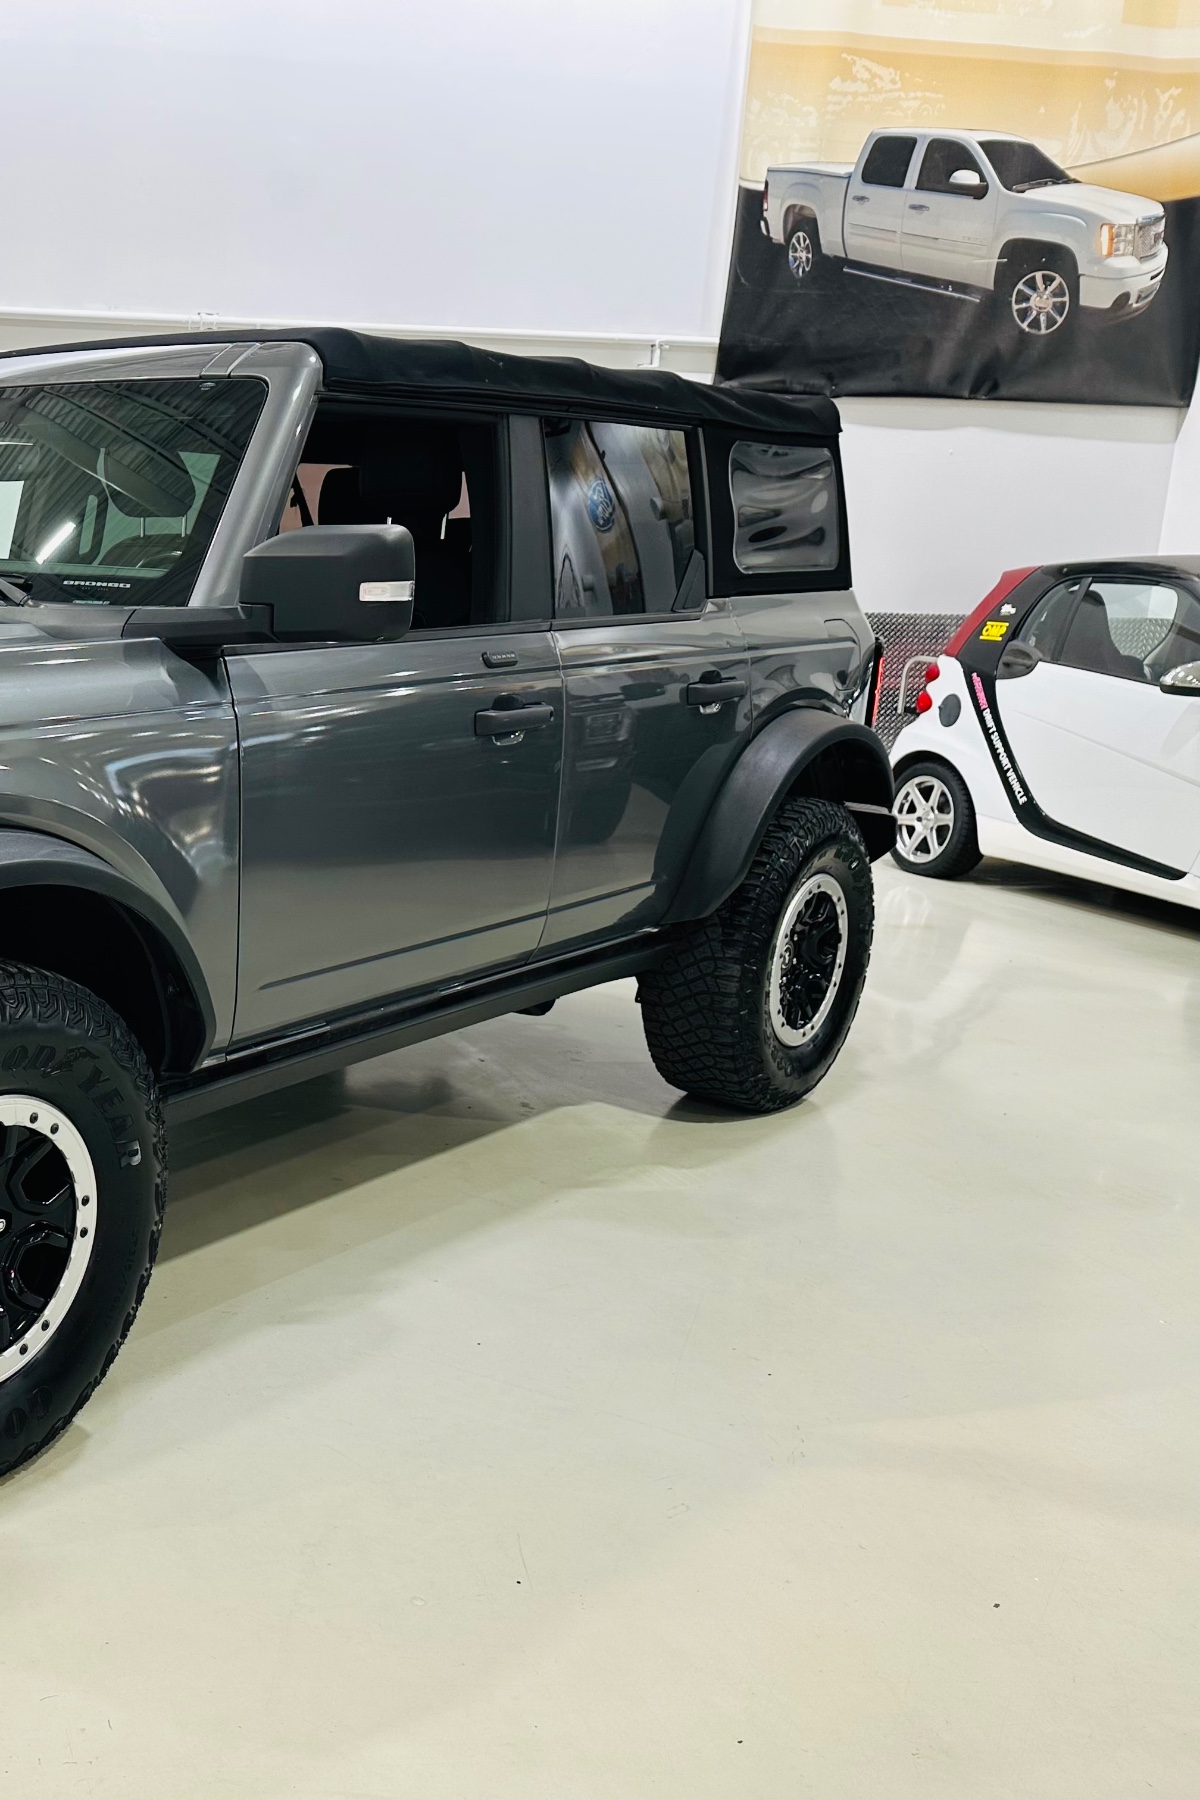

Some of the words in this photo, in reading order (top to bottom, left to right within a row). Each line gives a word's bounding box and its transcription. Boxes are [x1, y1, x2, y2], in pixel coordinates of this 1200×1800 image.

[982, 625, 1007, 637] OMP
[983, 708, 997, 734] DRIFT
[991, 731, 1012, 770] SUPPORT
[1006, 768, 1028, 806] VEHICLE
